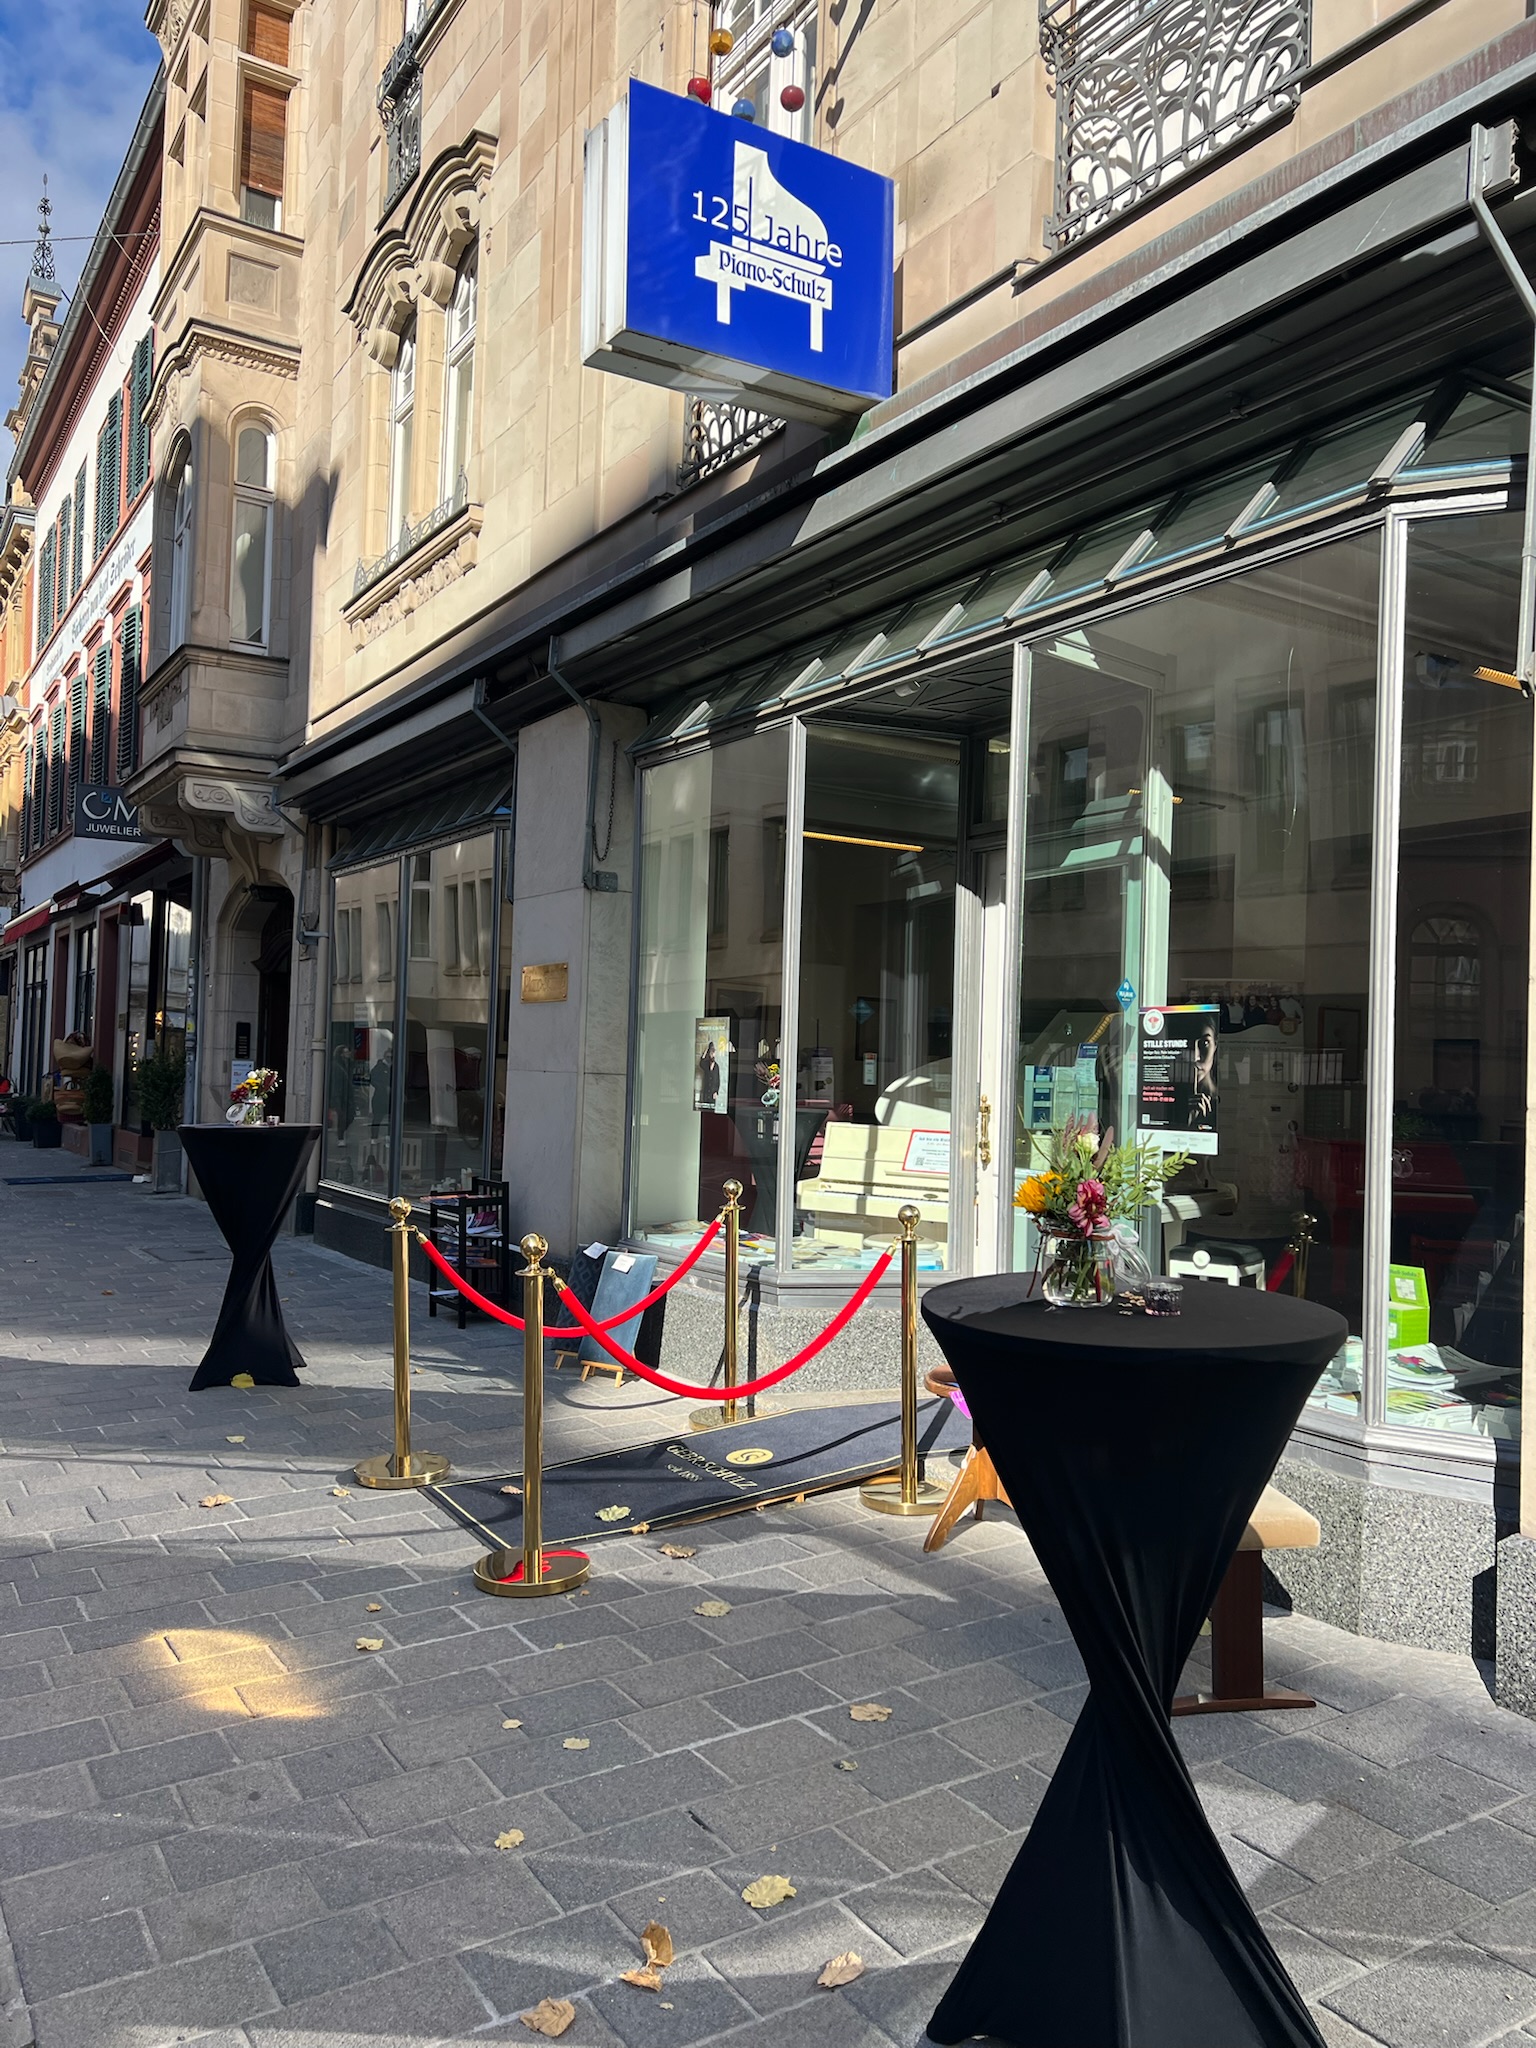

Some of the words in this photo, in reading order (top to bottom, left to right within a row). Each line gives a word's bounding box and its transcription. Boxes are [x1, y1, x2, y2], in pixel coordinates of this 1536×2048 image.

[692, 189, 749, 234] 125
[760, 214, 843, 268] Jahre
[718, 249, 826, 303] Piano-Schulz
[85, 822, 142, 837] JUWELIER
[1143, 1039, 1163, 1048] STILLE
[1163, 1039, 1188, 1048] STUNDE
[703, 1461, 758, 1490] SCHULZ
